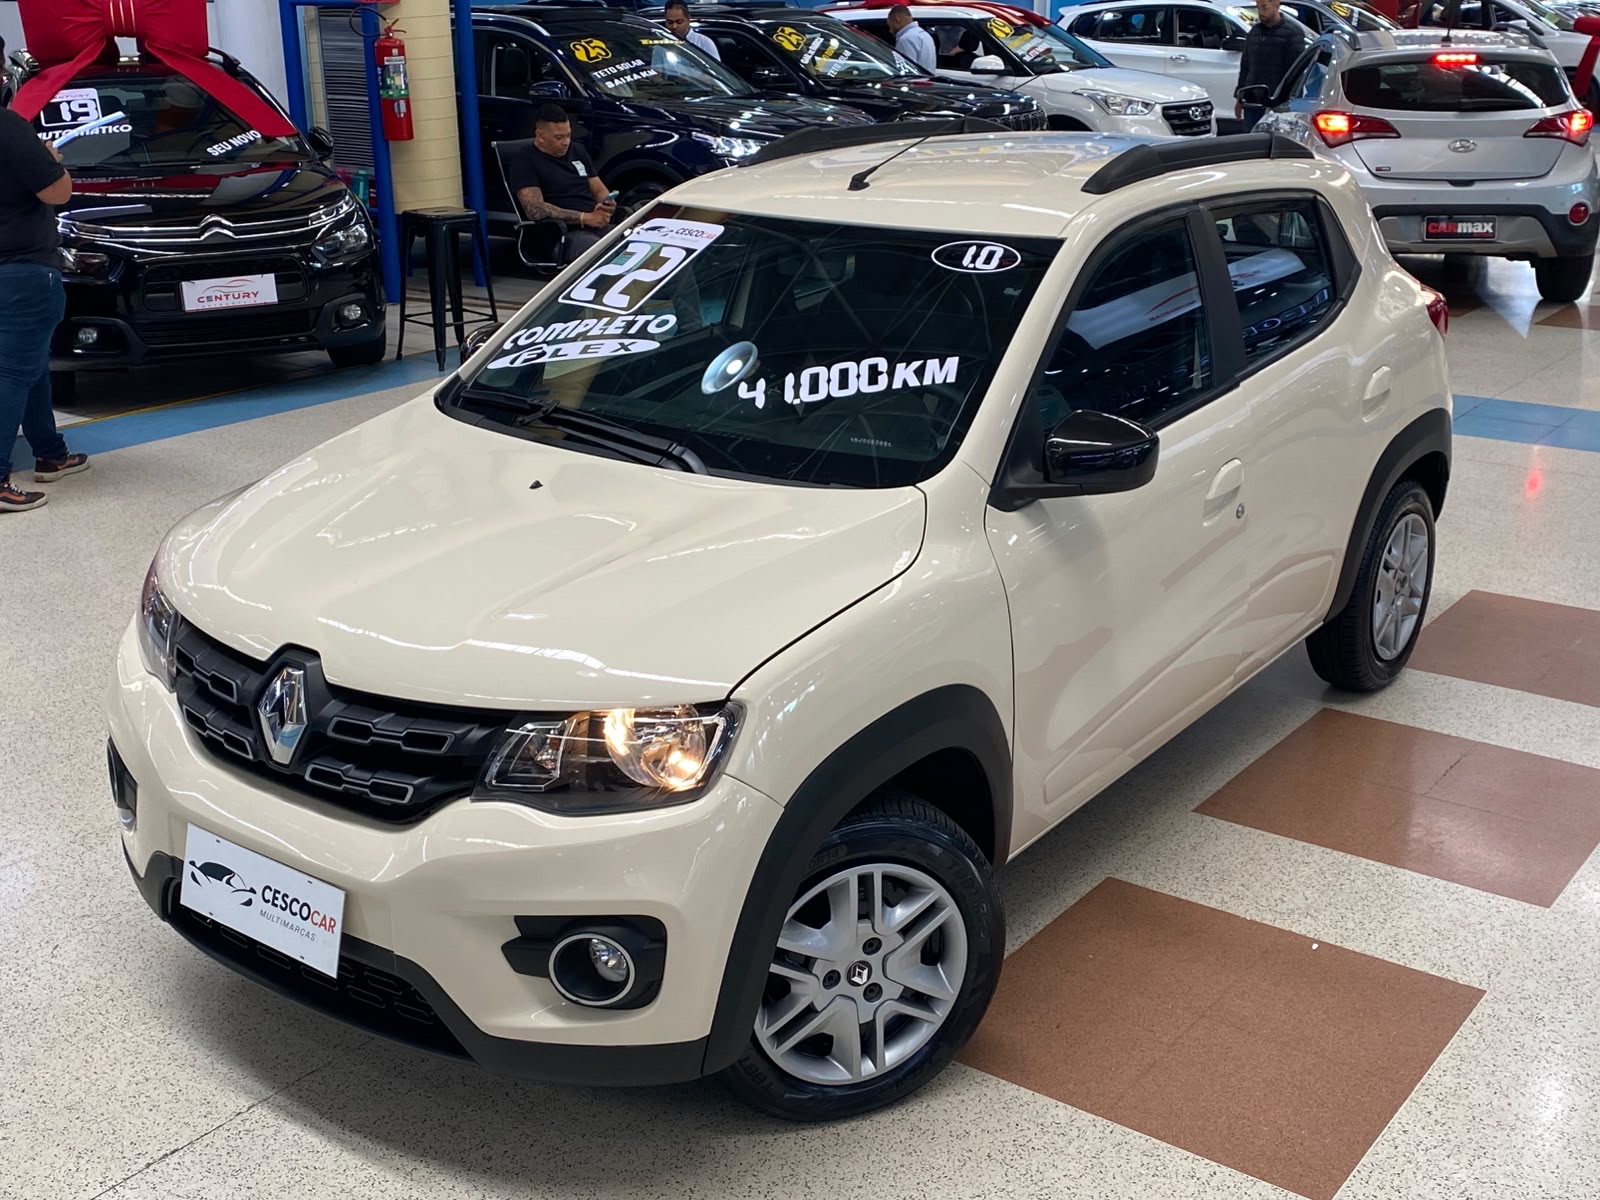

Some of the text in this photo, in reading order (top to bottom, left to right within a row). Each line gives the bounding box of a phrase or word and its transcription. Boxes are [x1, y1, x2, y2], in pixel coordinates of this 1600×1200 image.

[773, 26, 806, 50] 25
[571, 39, 611, 62] 25
[593, 59, 645, 79] TETO SOLAR
[605, 73, 641, 88] BAIXA
[60, 99, 98, 122] 19
[206, 129, 262, 156] SEU NOVO
[675, 227, 717, 240] CESCOCAR
[962, 245, 1004, 270] 1.0
[570, 242, 687, 308] 22
[197, 291, 259, 303] CENTURY
[503, 314, 677, 350] COMPLETO
[509, 342, 637, 366] FLEX
[261, 885, 336, 934] CESCOCAR
[259, 909, 316, 941] MULTIMARCAS
